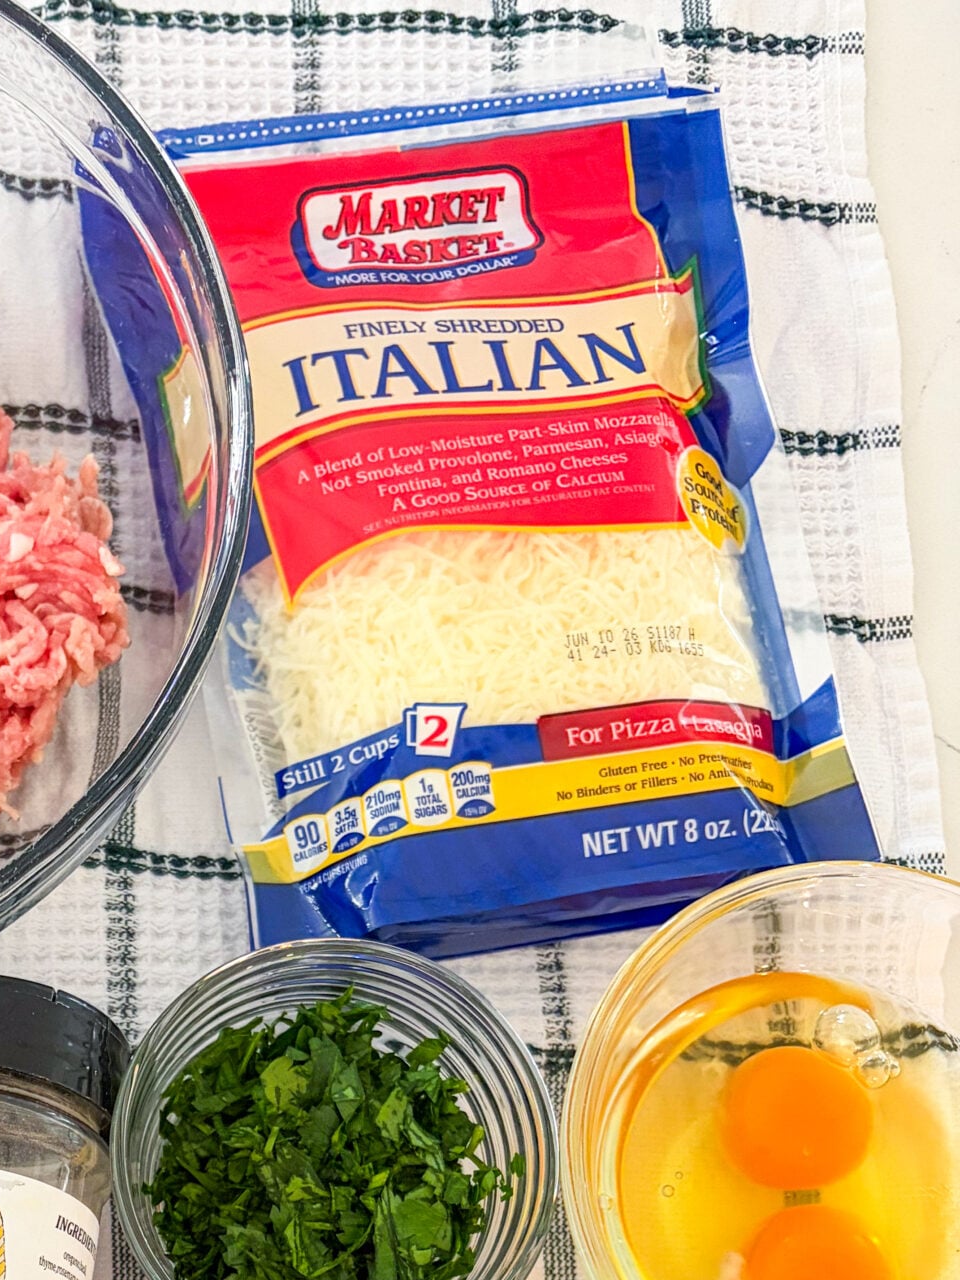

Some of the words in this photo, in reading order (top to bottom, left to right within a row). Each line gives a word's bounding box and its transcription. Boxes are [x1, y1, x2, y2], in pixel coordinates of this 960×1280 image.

[323, 187, 505, 239] MARKET
[338, 232, 504, 265] BASKET
[381, 270, 408, 285] FOR
[409, 268, 453, 283] YOUR
[343, 319, 427, 339] FINELY
[435, 317, 564, 335] SHREDDED
[282, 321, 647, 418] ITALIAN
[313, 451, 362, 478] Blend
[368, 447, 385, 464] of
[389, 430, 504, 459] Low-Moisture
[507, 418, 590, 442] Part-Skim
[594, 410, 676, 430] Mozzarella
[320, 477, 352, 495] Not
[356, 458, 424, 484] Smoked
[428, 448, 518, 471] Provolone,
[523, 435, 609, 458] Parmesan,
[377, 476, 447, 498] Fontina,
[451, 468, 482, 485] and
[487, 462, 556, 482] Romano
[560, 452, 628, 470] Cheeses
[411, 491, 461, 509] GOOD
[464, 482, 528, 502] SOURCE
[532, 480, 552, 494] OF
[555, 470, 625, 489] CALCIUM
[564, 630, 589, 649] JUN
[623, 627, 639, 642] 26
[419, 714, 449, 748] 2
[566, 727, 603, 747] For
[611, 717, 676, 741] Pizza
[282, 761, 325, 790] Still
[331, 756, 345, 774] 2
[349, 733, 400, 766] Cups
[599, 764, 638, 779] Gluten
[640, 759, 668, 773] Free
[679, 756, 695, 768] No
[419, 778, 433, 793] 1g
[452, 769, 491, 788] 200mg
[556, 790, 573, 802] No
[576, 783, 621, 799] Binders
[624, 781, 639, 792] or
[641, 775, 678, 789] Fillers
[689, 771, 705, 783] No
[365, 790, 401, 810] 210mg
[294, 820, 321, 849] 90
[581, 826, 630, 858] NET
[636, 820, 678, 850] WT
[684, 818, 698, 843] 8
[293, 841, 328, 863] CALORIES
